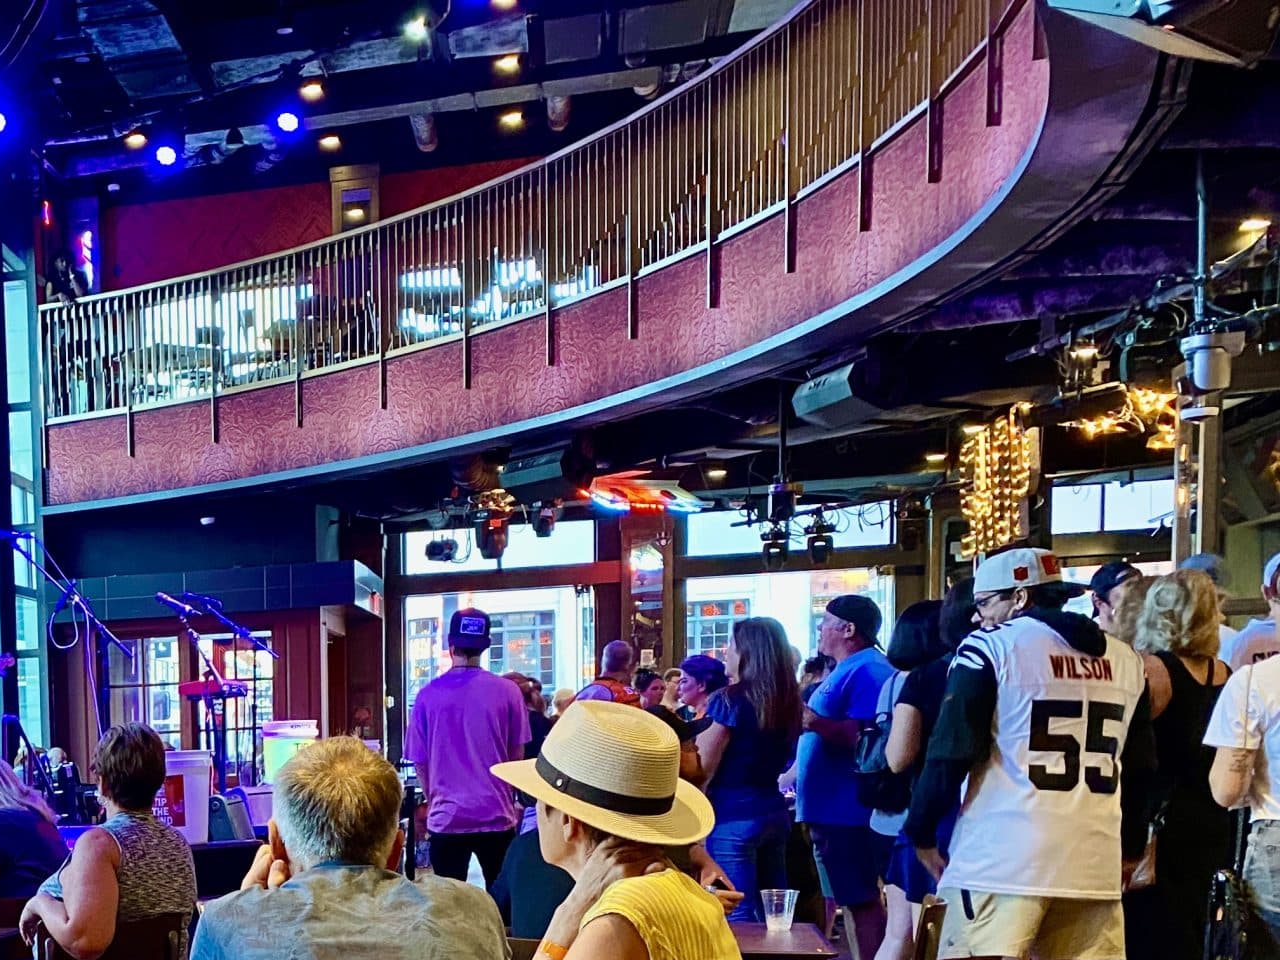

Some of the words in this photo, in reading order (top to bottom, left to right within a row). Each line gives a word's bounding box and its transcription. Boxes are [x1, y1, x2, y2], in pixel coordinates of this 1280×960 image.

[1049, 654, 1113, 681] WILSON
[1028, 699, 1125, 794] 55
[154, 797, 167, 806] TIP
[151, 806, 169, 816] THE
